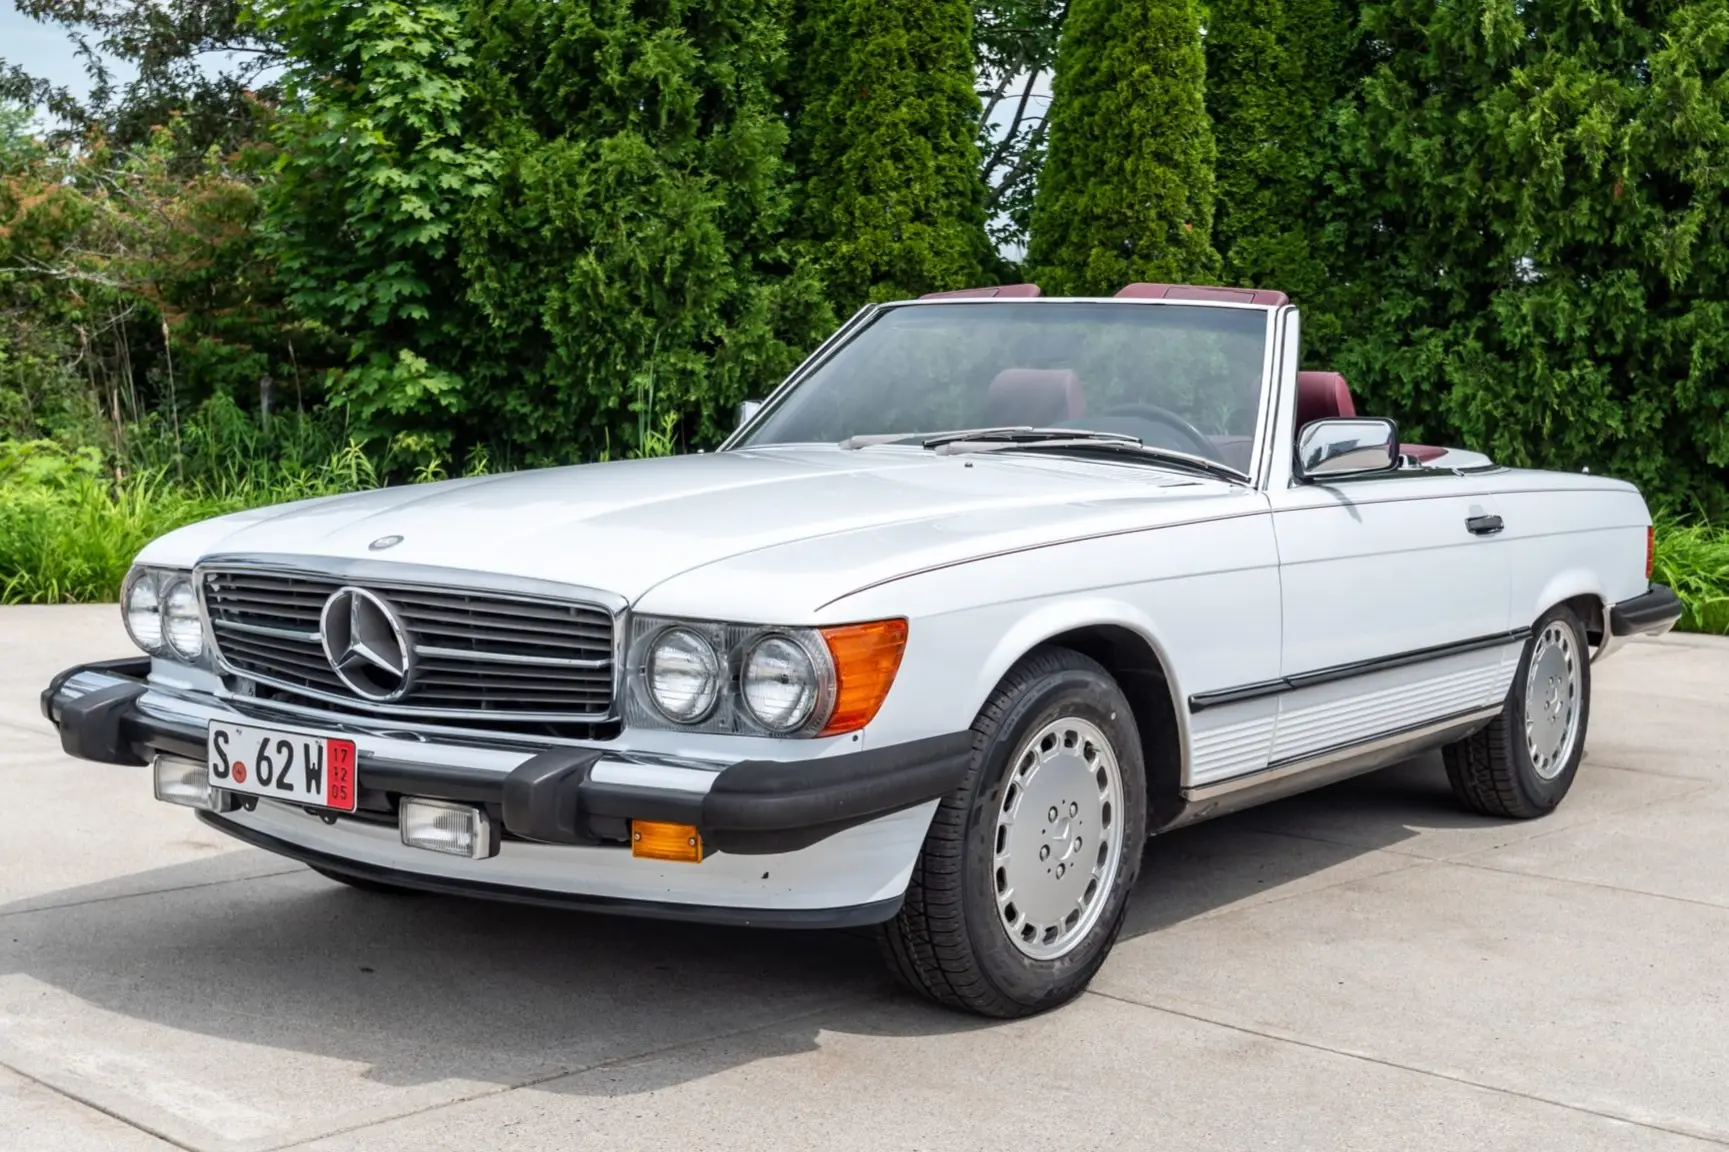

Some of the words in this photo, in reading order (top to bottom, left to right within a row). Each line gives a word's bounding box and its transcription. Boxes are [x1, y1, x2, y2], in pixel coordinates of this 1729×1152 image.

[213, 730, 229, 778] S
[256, 737, 294, 791] 62
[304, 743, 323, 794] W
[333, 748, 347, 763] 17
[332, 786, 347, 800] 05
